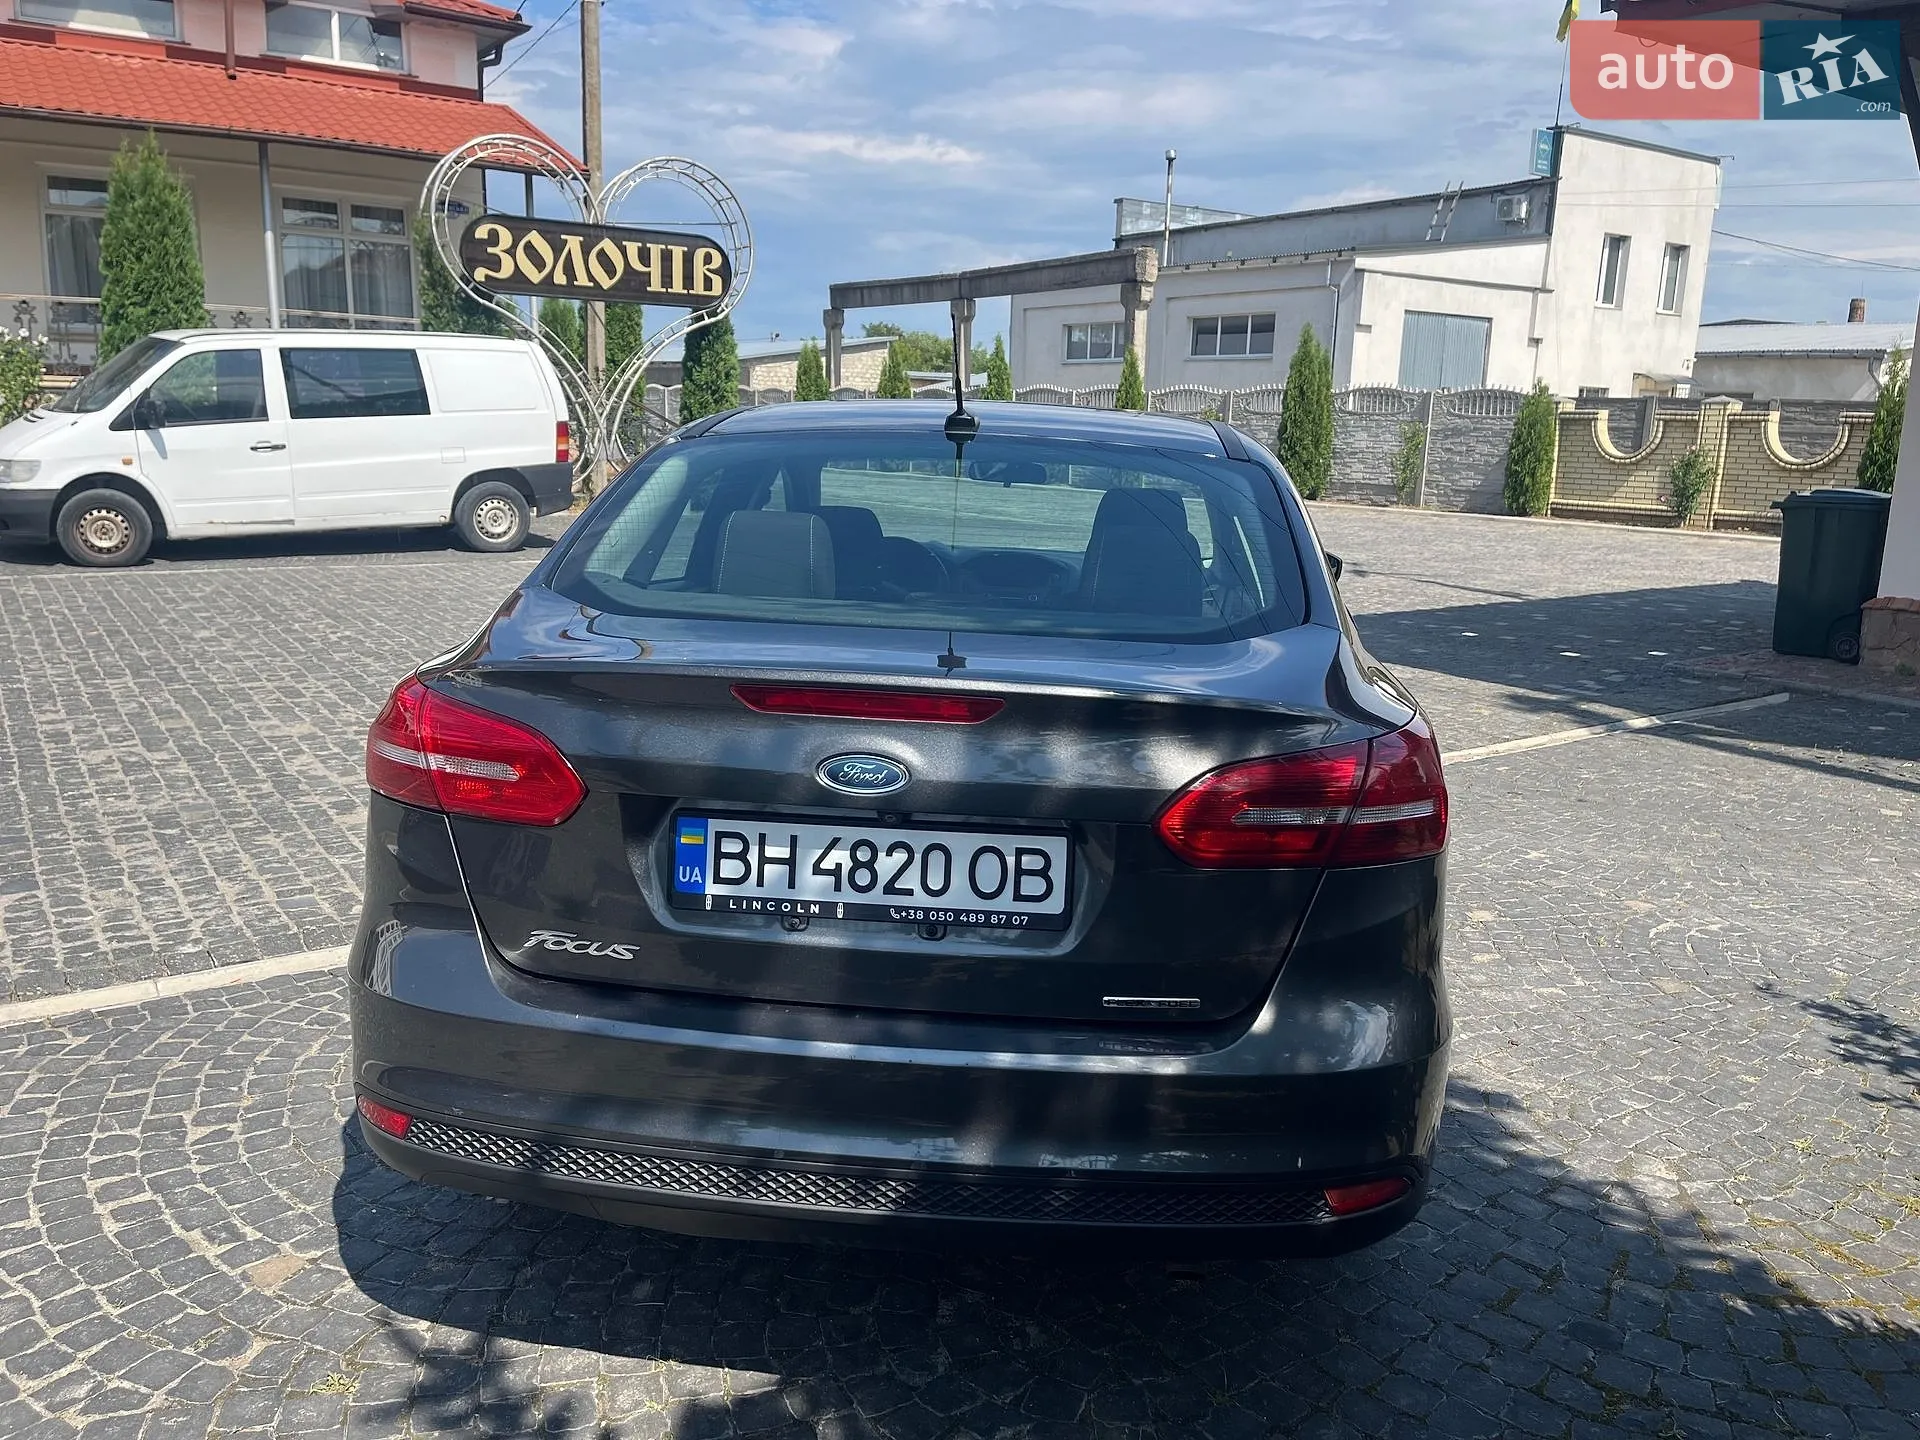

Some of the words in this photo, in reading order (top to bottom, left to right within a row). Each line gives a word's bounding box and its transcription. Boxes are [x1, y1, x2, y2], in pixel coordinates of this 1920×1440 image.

[838, 762, 888, 784] Ford
[679, 865, 703, 884] UA
[712, 830, 798, 890] BH
[812, 836, 952, 898] 4820
[968, 844, 1054, 903] OB
[729, 898, 820, 914] LINCOLN
[900, 909, 924, 920] +38
[929, 911, 954, 921] 050
[960, 912, 985, 923] 489
[990, 914, 1007, 925] 87
[1012, 915, 1029, 926] 07
